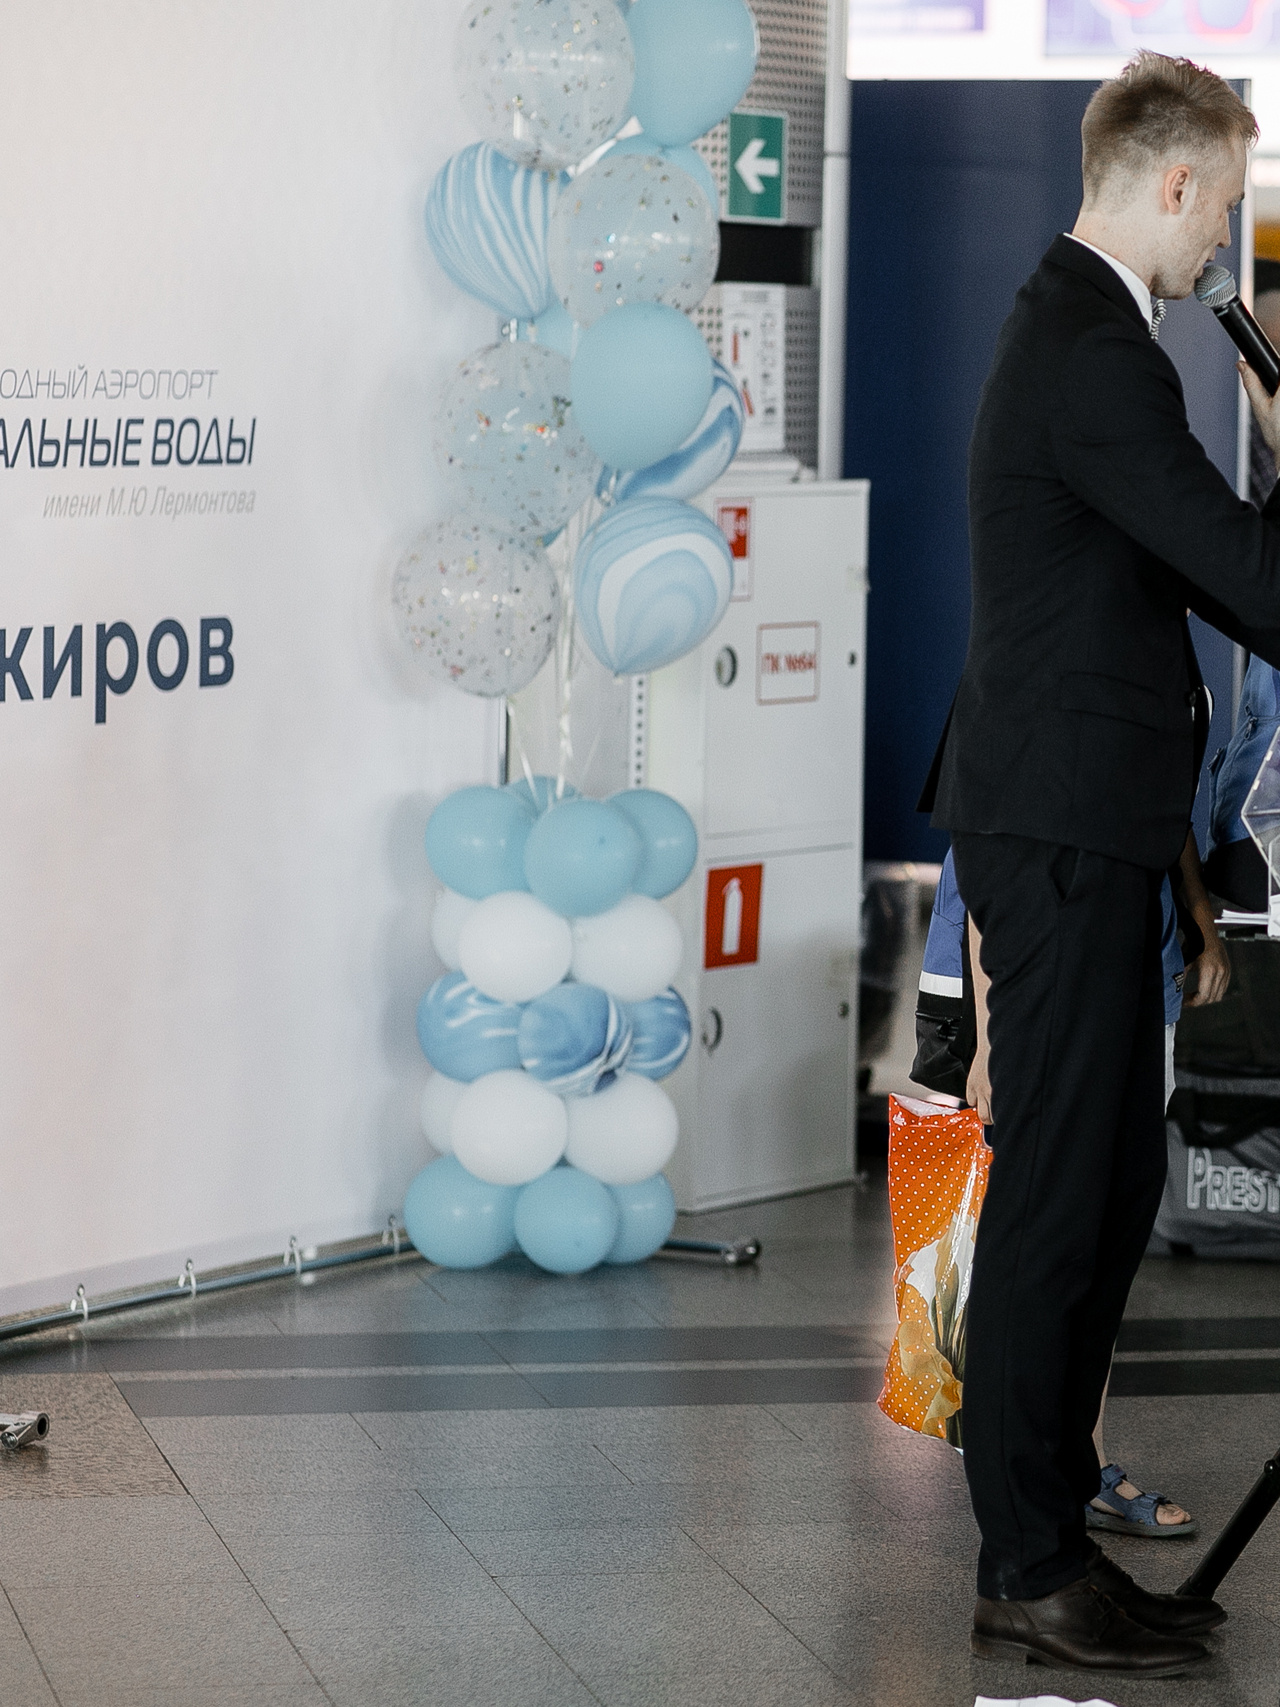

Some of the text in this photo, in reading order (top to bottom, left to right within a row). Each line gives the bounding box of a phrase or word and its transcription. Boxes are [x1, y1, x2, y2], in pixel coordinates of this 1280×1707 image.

[0, 364, 219, 400] ОДНЫЙ АЭРОПОРТ
[151, 417, 257, 466] ВОДЫ
[42, 495, 101, 518] имени
[150, 486, 256, 520] Лермонтова
